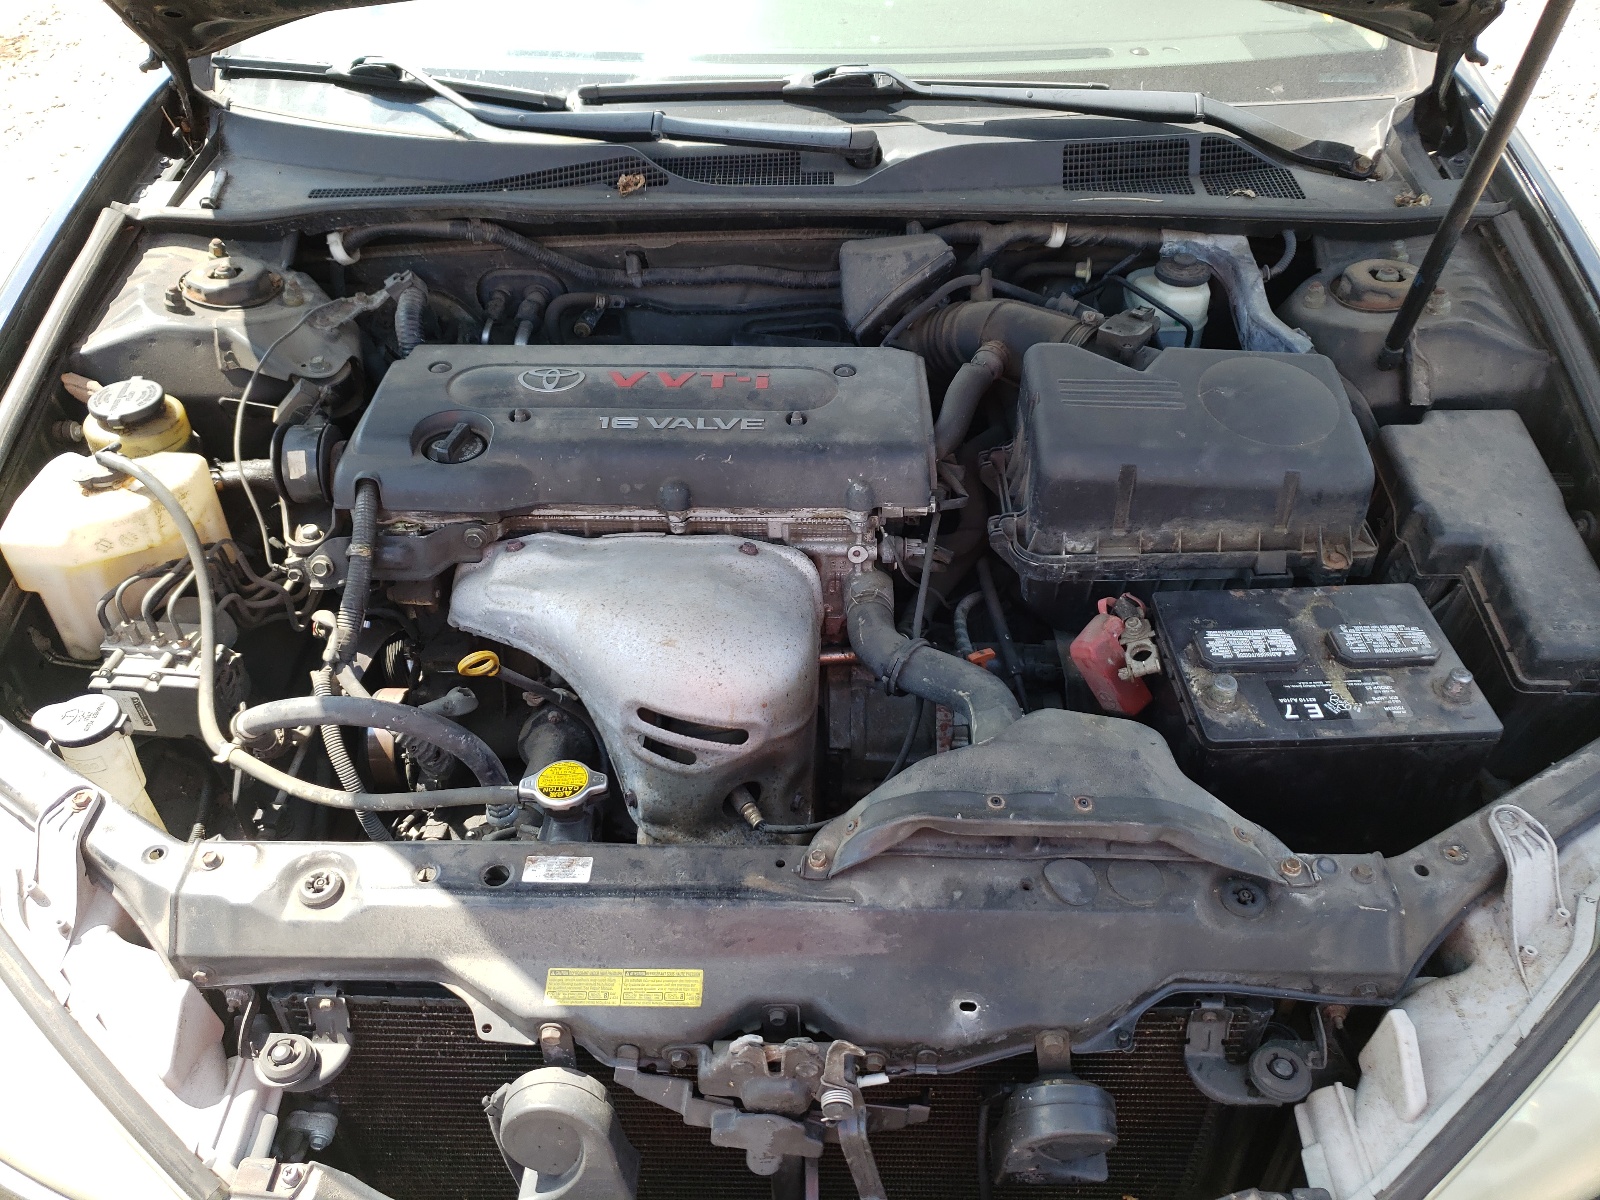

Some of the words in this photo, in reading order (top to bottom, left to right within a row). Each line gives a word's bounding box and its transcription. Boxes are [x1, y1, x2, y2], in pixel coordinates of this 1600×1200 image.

[608, 371, 770, 389] VVT-i
[600, 416, 639, 429] 16
[646, 417, 765, 430] VALVE
[542, 785, 580, 793] CAUTION
